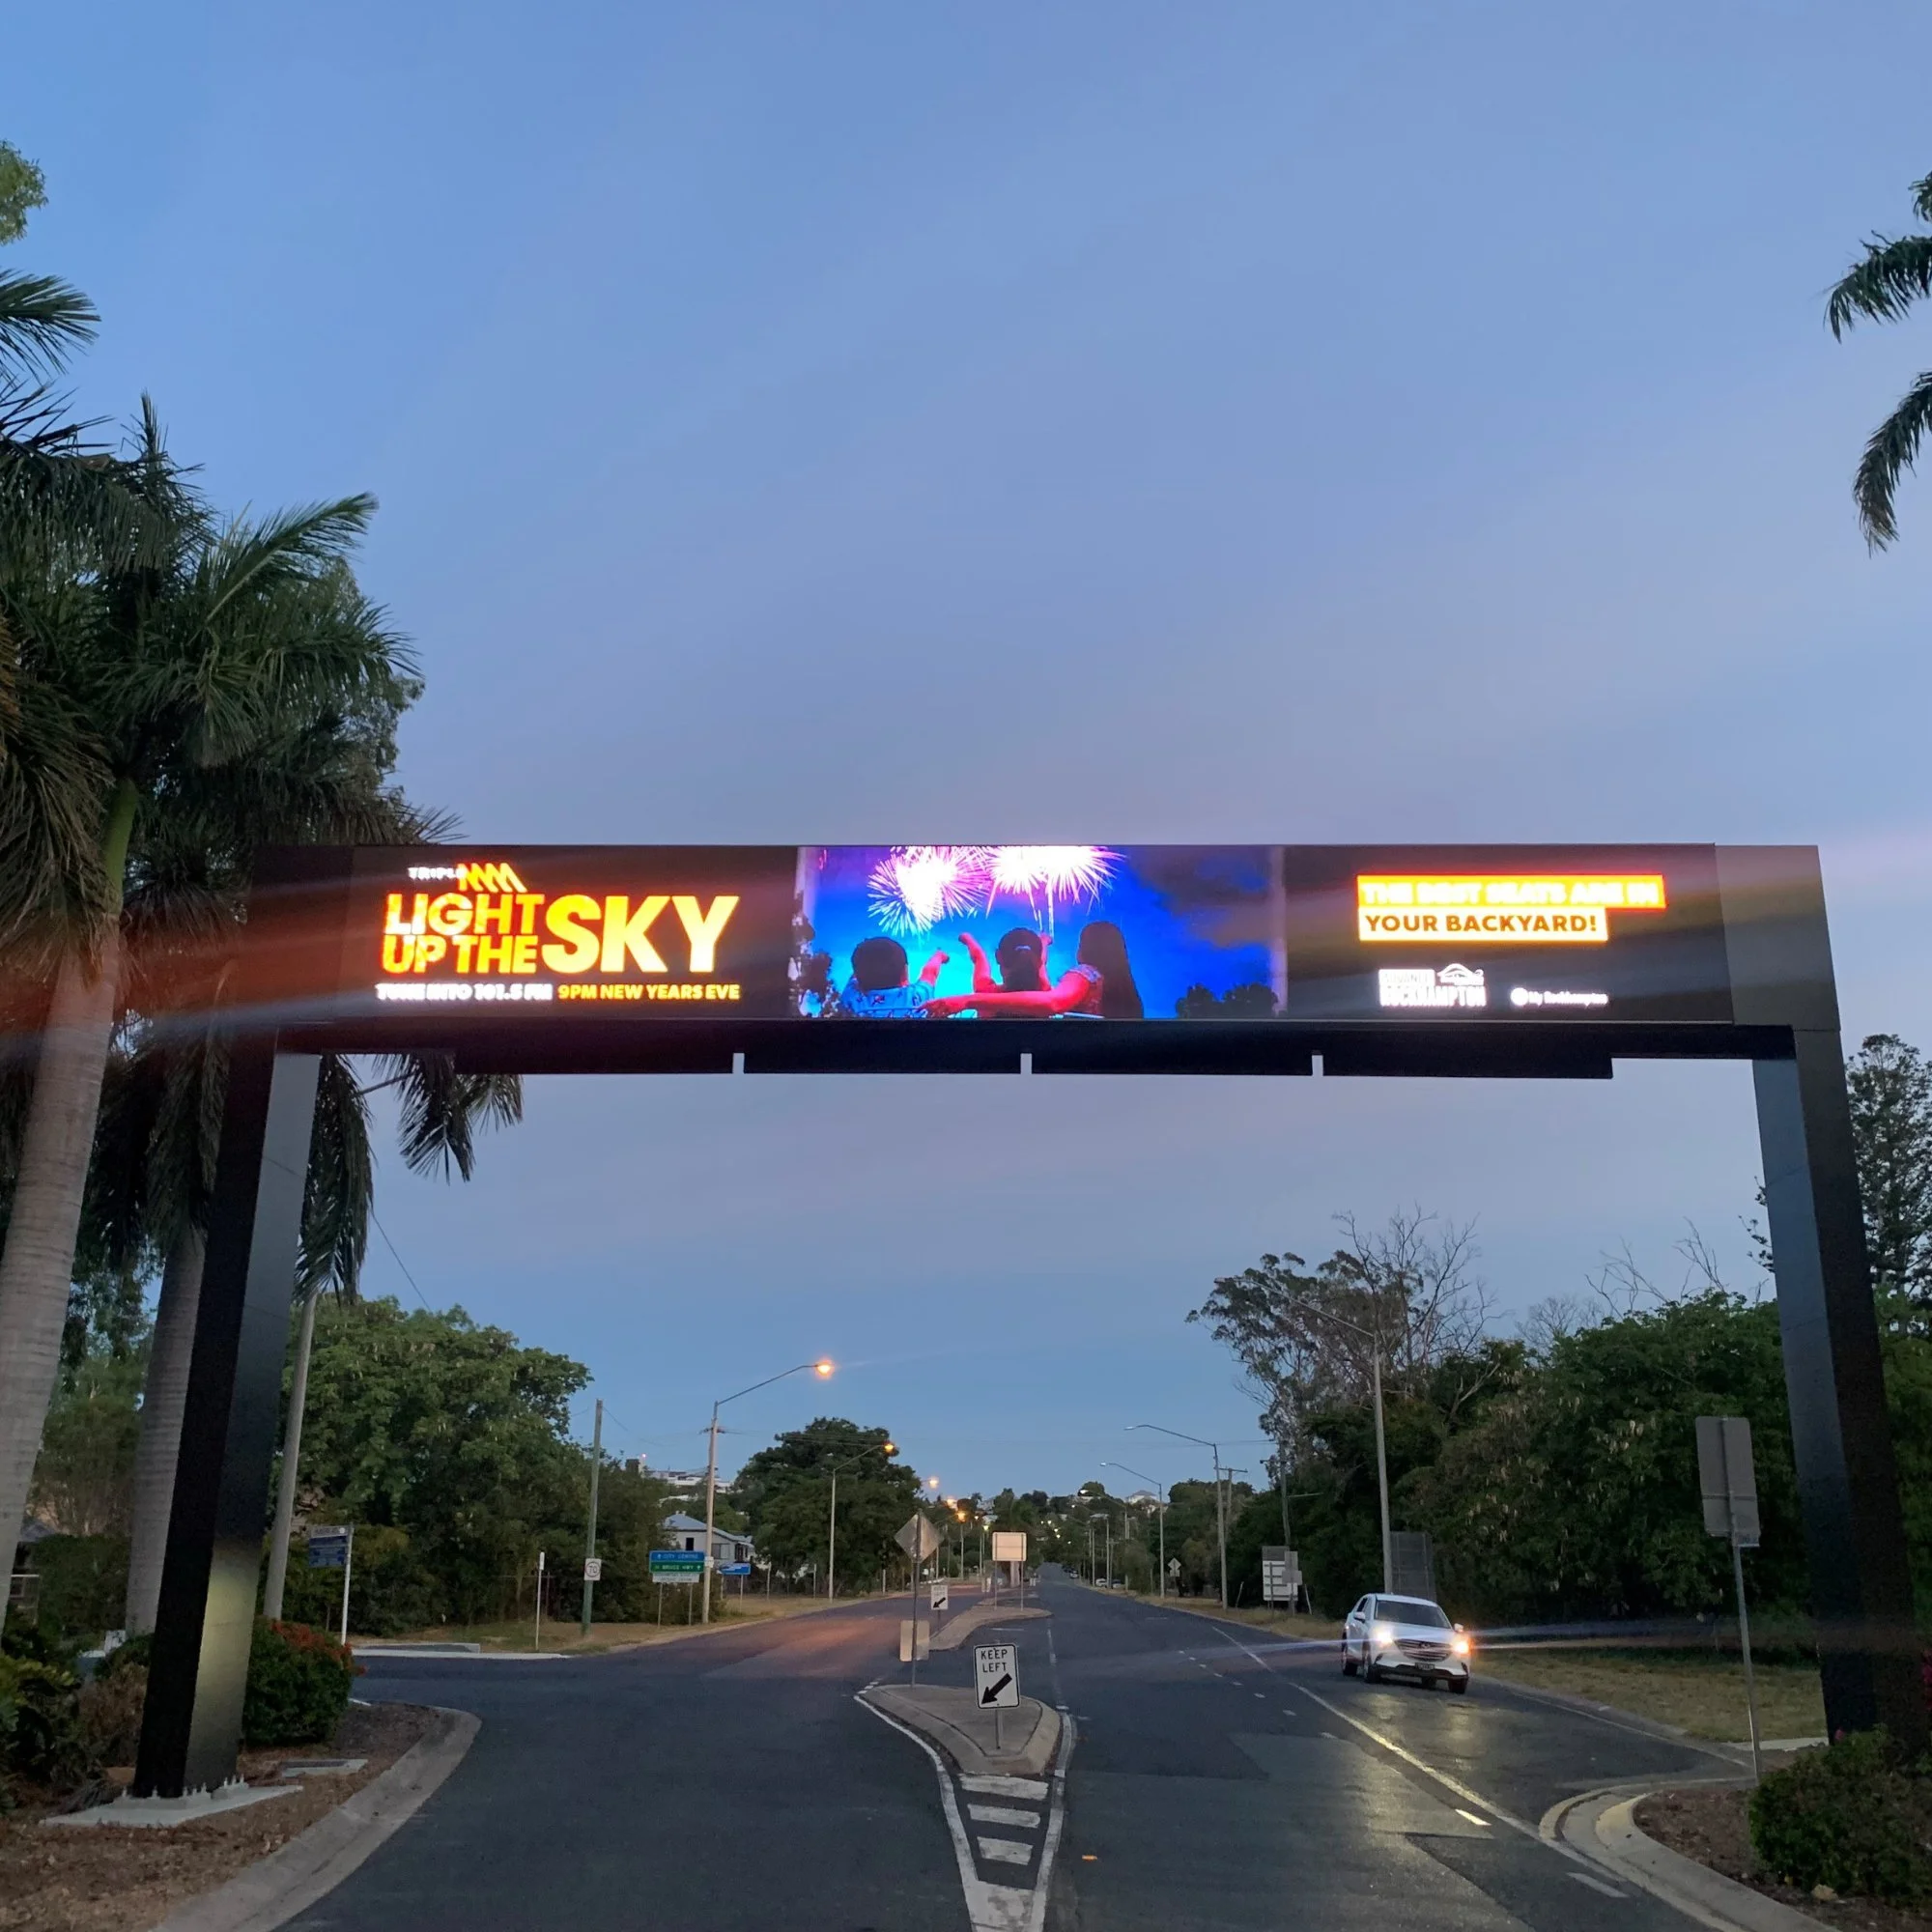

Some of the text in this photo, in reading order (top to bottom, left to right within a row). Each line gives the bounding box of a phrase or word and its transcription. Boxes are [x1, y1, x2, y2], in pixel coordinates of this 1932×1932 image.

[384, 894, 544, 935] LIGHT
[1365, 915, 1597, 932] YOUR BACKYARD!
[542, 895, 740, 973] SKY
[383, 935, 538, 974] UP THE
[557, 984, 741, 1000] 9PM NEW YEARS EVE
[980, 1649, 1008, 1661] KEEP
[982, 1662, 1008, 1673] LEFT
